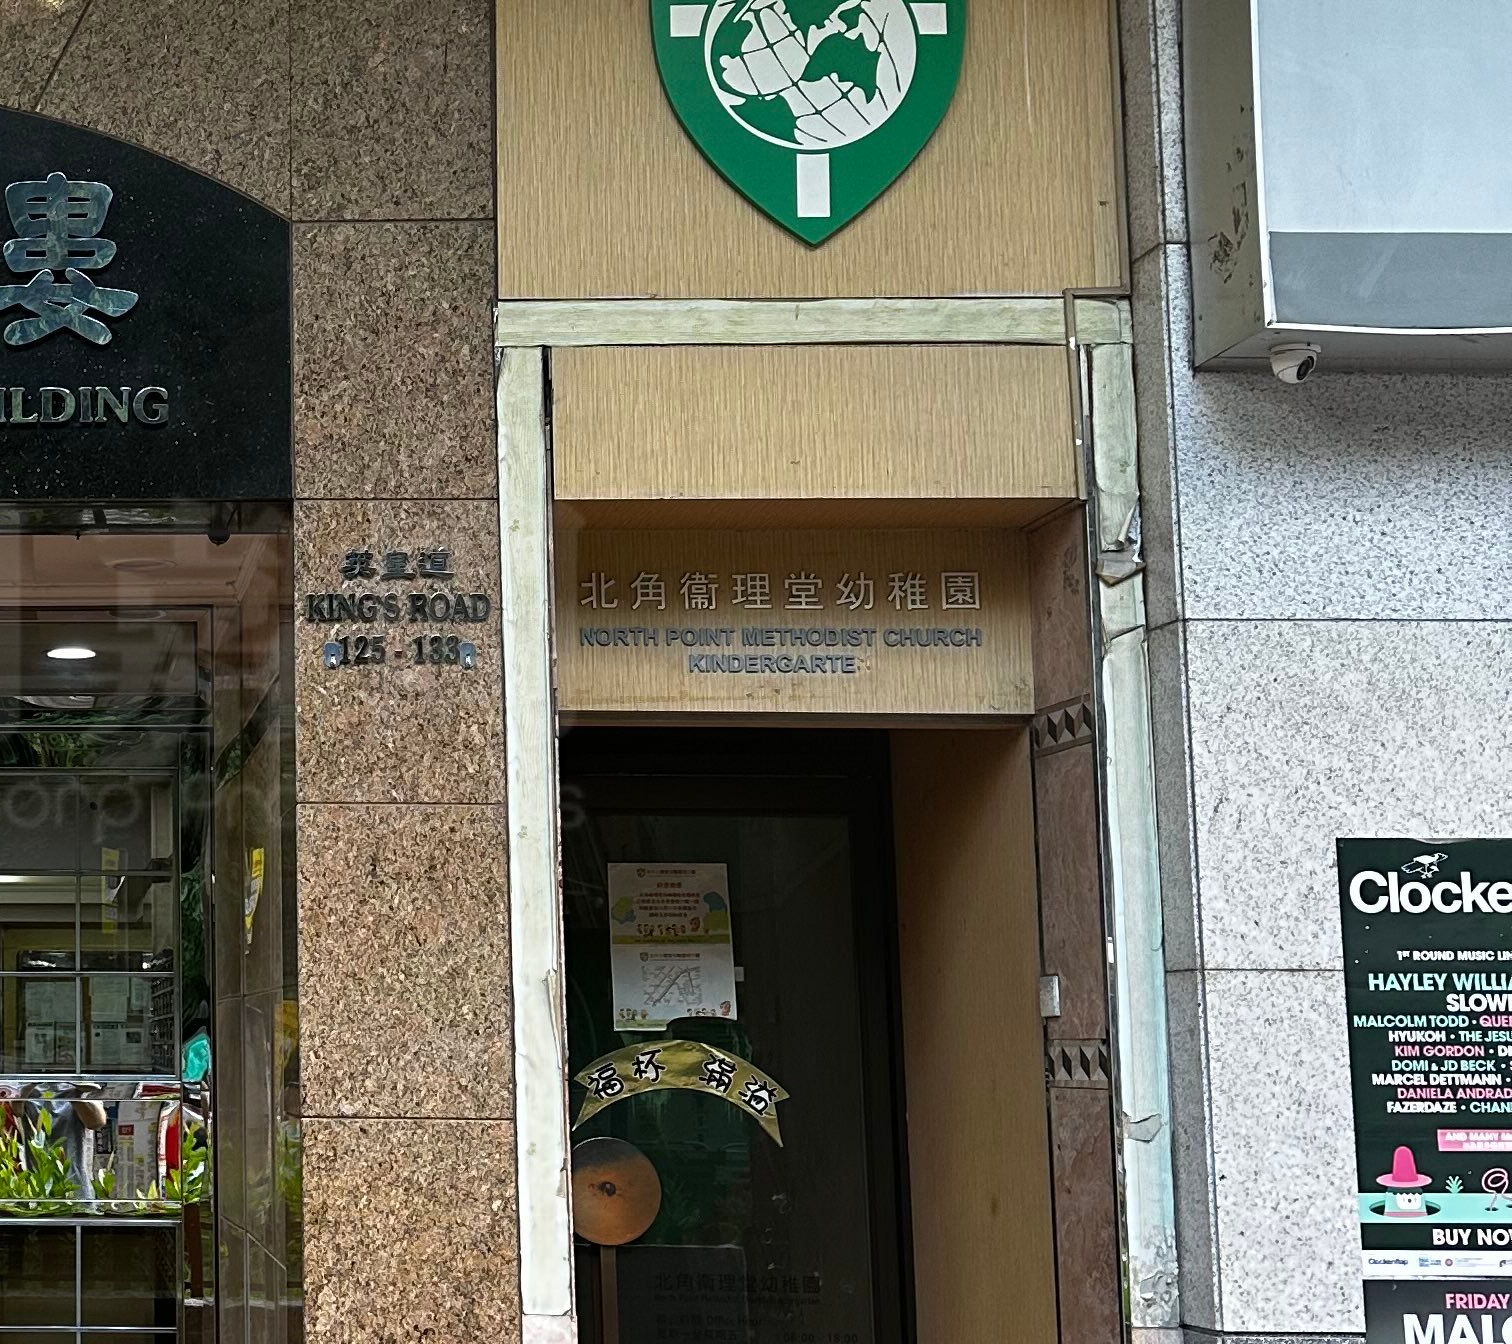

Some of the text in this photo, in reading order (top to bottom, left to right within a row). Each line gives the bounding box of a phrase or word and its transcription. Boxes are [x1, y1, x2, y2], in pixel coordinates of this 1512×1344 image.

[340, 547, 455, 580] 英皇道
[305, 592, 491, 623] KING'S ROAD
[580, 626, 983, 648] NORTH POINT METHODIST CHURCH
[338, 634, 386, 665] 125
[413, 633, 460, 665] 133
[1349, 870, 1512, 914] Clocke
[1413, 950, 1455, 961] ROUND
[1457, 950, 1495, 961] MUSIC
[1368, 972, 1512, 991] HAYLEY WILLI
[1446, 993, 1512, 1012] SLOW
[1353, 1015, 1427, 1028] MALCOLM
[1429, 1015, 1469, 1028] TODD
[1388, 1030, 1447, 1042] HYUKOH
[1458, 1030, 1482, 1042] THE
[1394, 1045, 1420, 1057] KIM
[1422, 1045, 1485, 1057] GORDON
[1391, 1060, 1429, 1071] DOMI
[1440, 1060, 1458, 1071] JD
[1460, 1060, 1496, 1071] BECK
[1371, 1073, 1502, 1086] MARCEL DETTMANN
[1397, 1087, 1454, 1099] DANIELA
[1387, 1101, 1457, 1113] FAZERDAZE
[1432, 1228, 1512, 1246] BUY NO
[1445, 1293, 1511, 1310] FRIDAY
